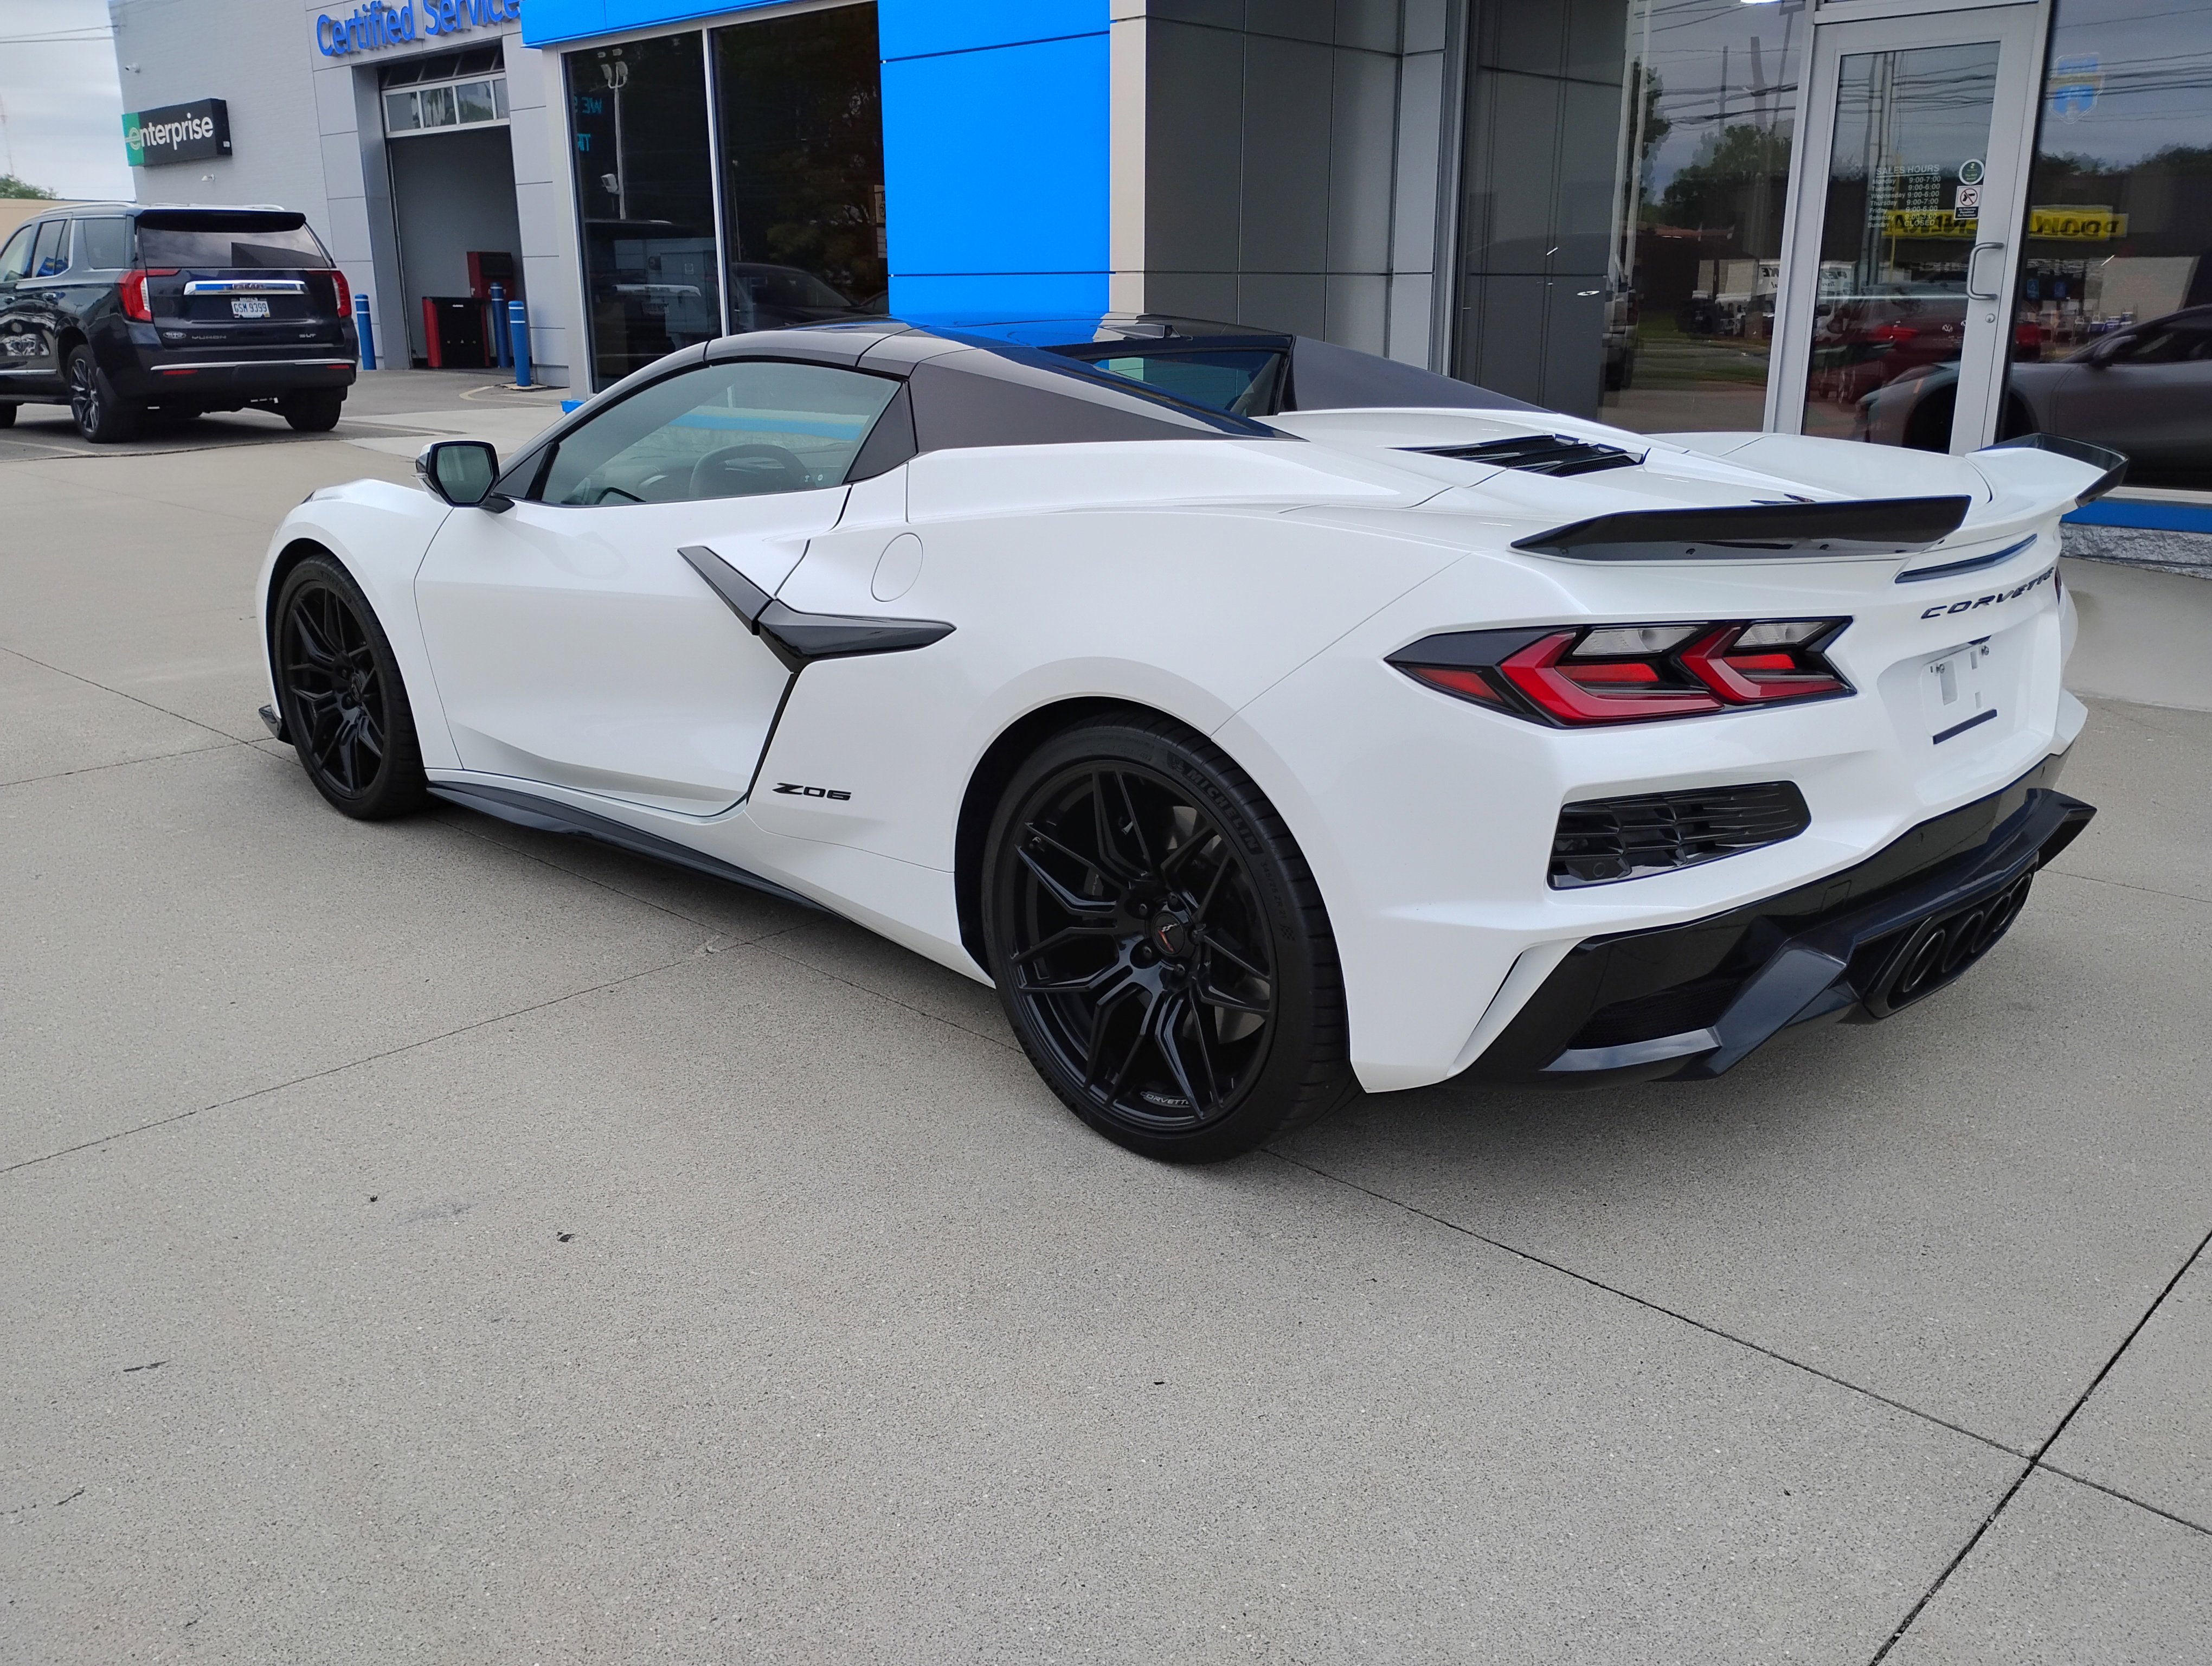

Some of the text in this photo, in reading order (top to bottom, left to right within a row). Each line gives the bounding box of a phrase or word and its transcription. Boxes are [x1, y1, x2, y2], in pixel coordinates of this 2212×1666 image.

[317, 0, 520, 56] Certified Service
[125, 112, 213, 151] enterprise
[1876, 164, 1940, 175] SALES HOURS
[1904, 219, 1935, 227] CLOSED
[234, 303, 267, 313] GSM 9399
[1920, 567, 2054, 619] CORVETTE
[772, 783, 852, 801] Z06
[1186, 768, 1258, 849] MICHELIN
